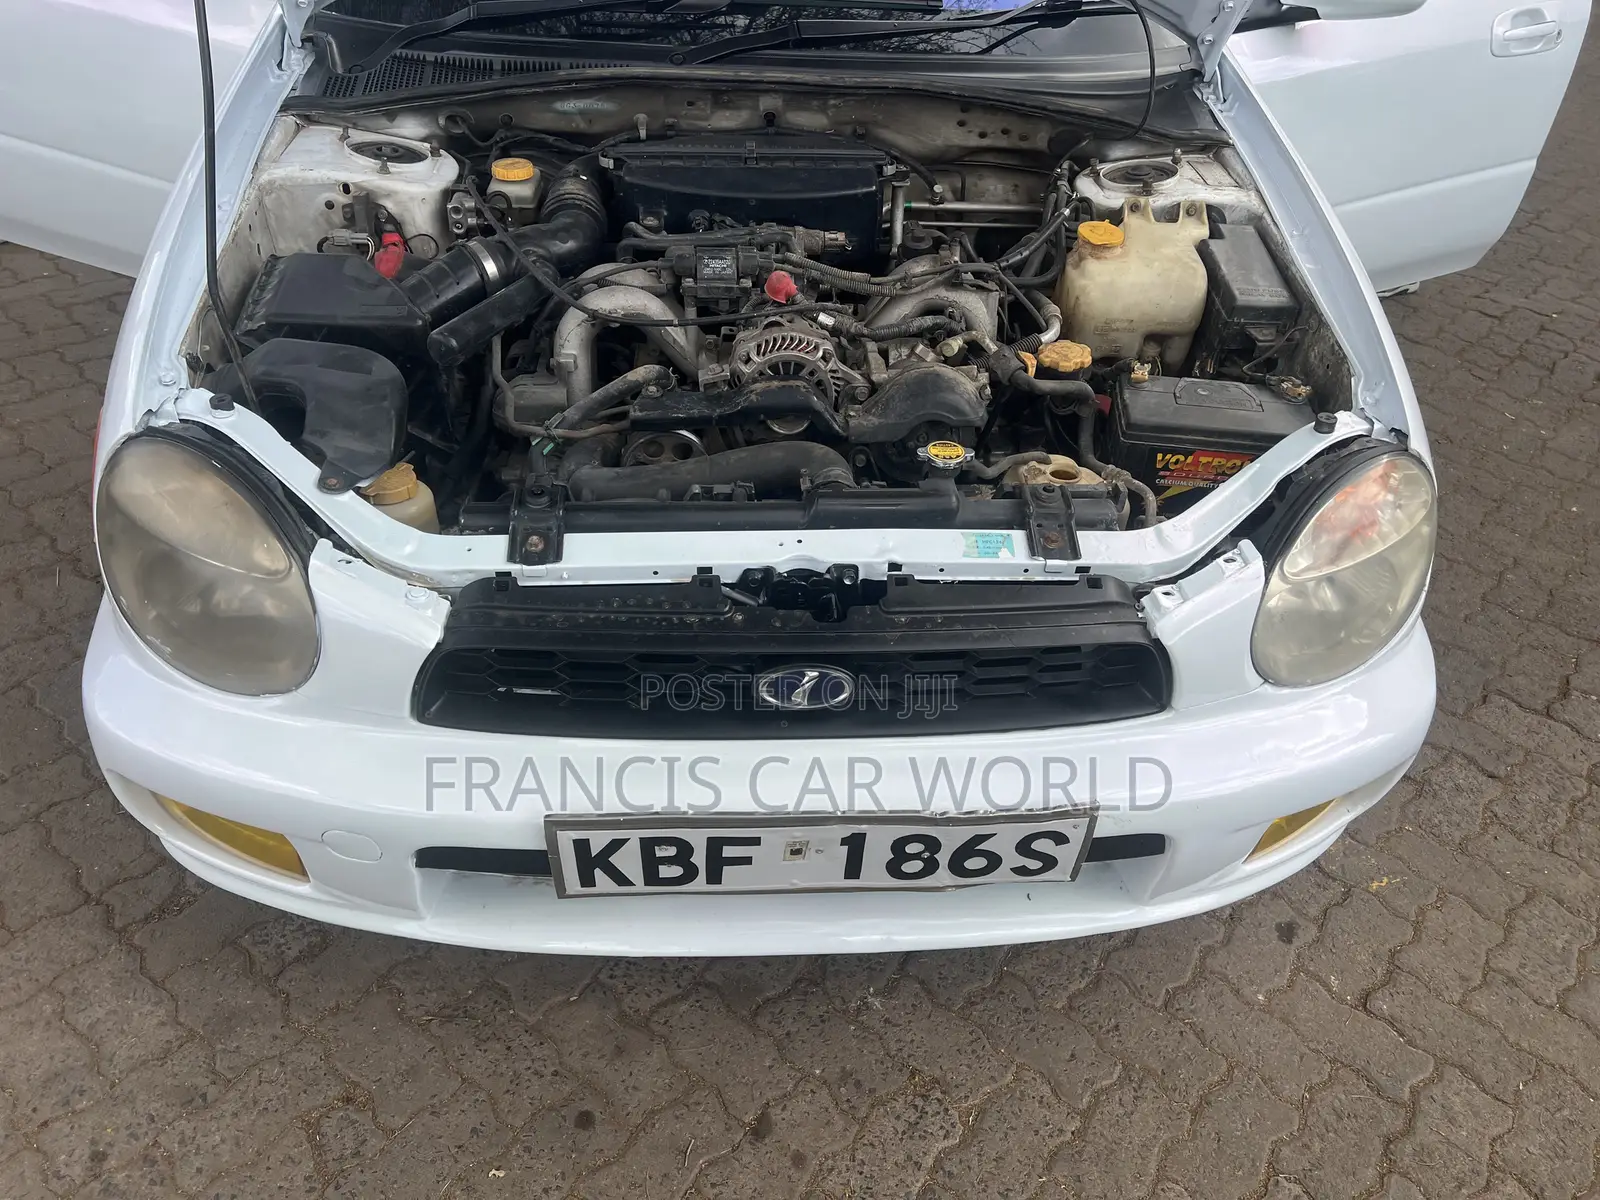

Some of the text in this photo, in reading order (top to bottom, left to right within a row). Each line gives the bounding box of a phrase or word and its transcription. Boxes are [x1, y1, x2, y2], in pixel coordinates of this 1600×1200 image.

[1156, 452, 1251, 475] VOLTRO
[1155, 478, 1188, 487] CALCIUM
[572, 830, 1071, 888] KBF 186S
